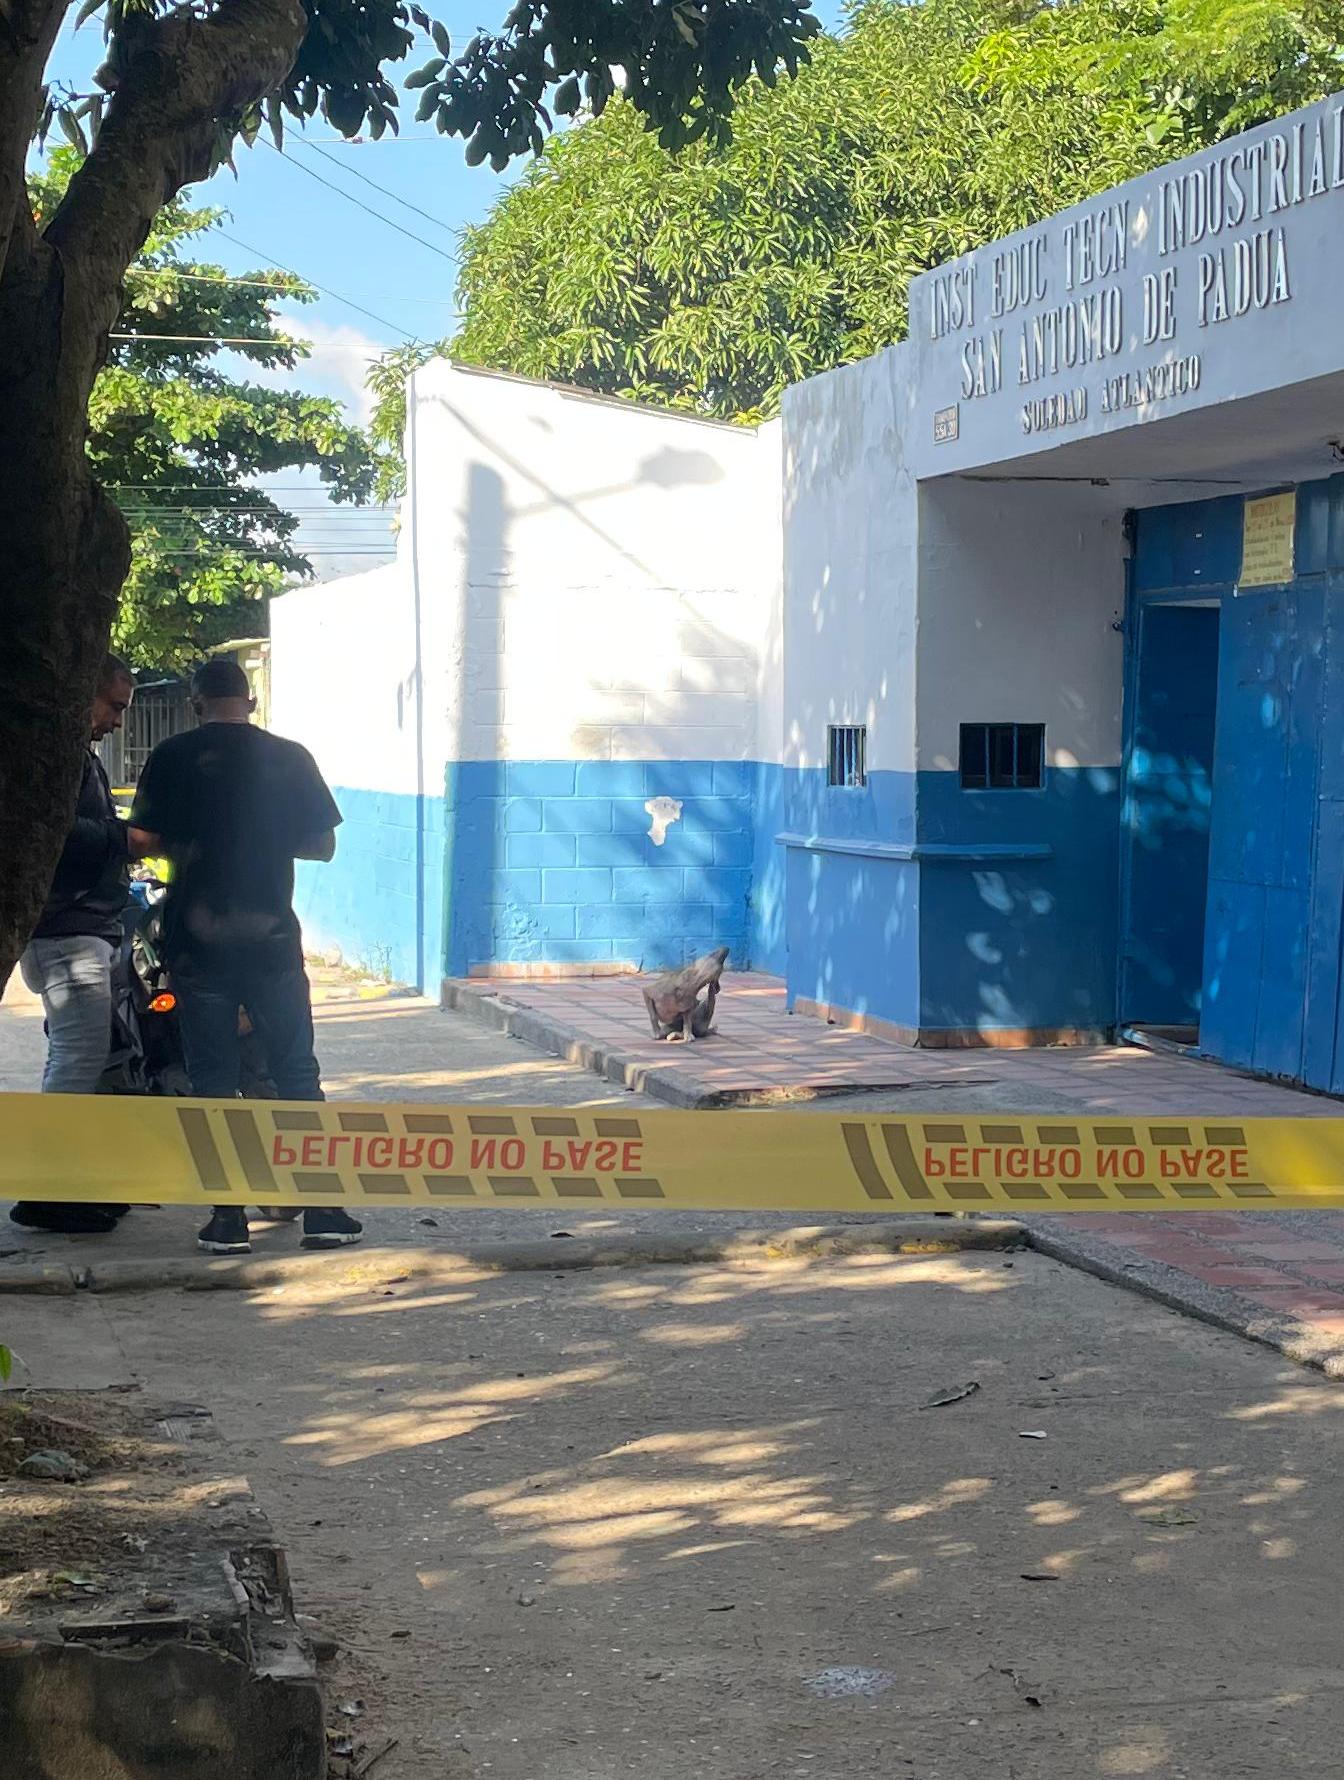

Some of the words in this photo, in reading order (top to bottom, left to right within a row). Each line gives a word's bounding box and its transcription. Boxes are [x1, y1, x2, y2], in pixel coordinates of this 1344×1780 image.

[930, 260, 977, 340] INST
[991, 234, 1047, 318] EDUC
[1063, 200, 1129, 291] TECN
[961, 328, 1003, 400] SAN
[1018, 286, 1122, 386] ANTONIO
[1143, 266, 1178, 346] DE
[1198, 226, 1292, 328] PADUA
[1022, 385, 1088, 435] SOLEDAD
[1101, 354, 1201, 414] ATLANTICO
